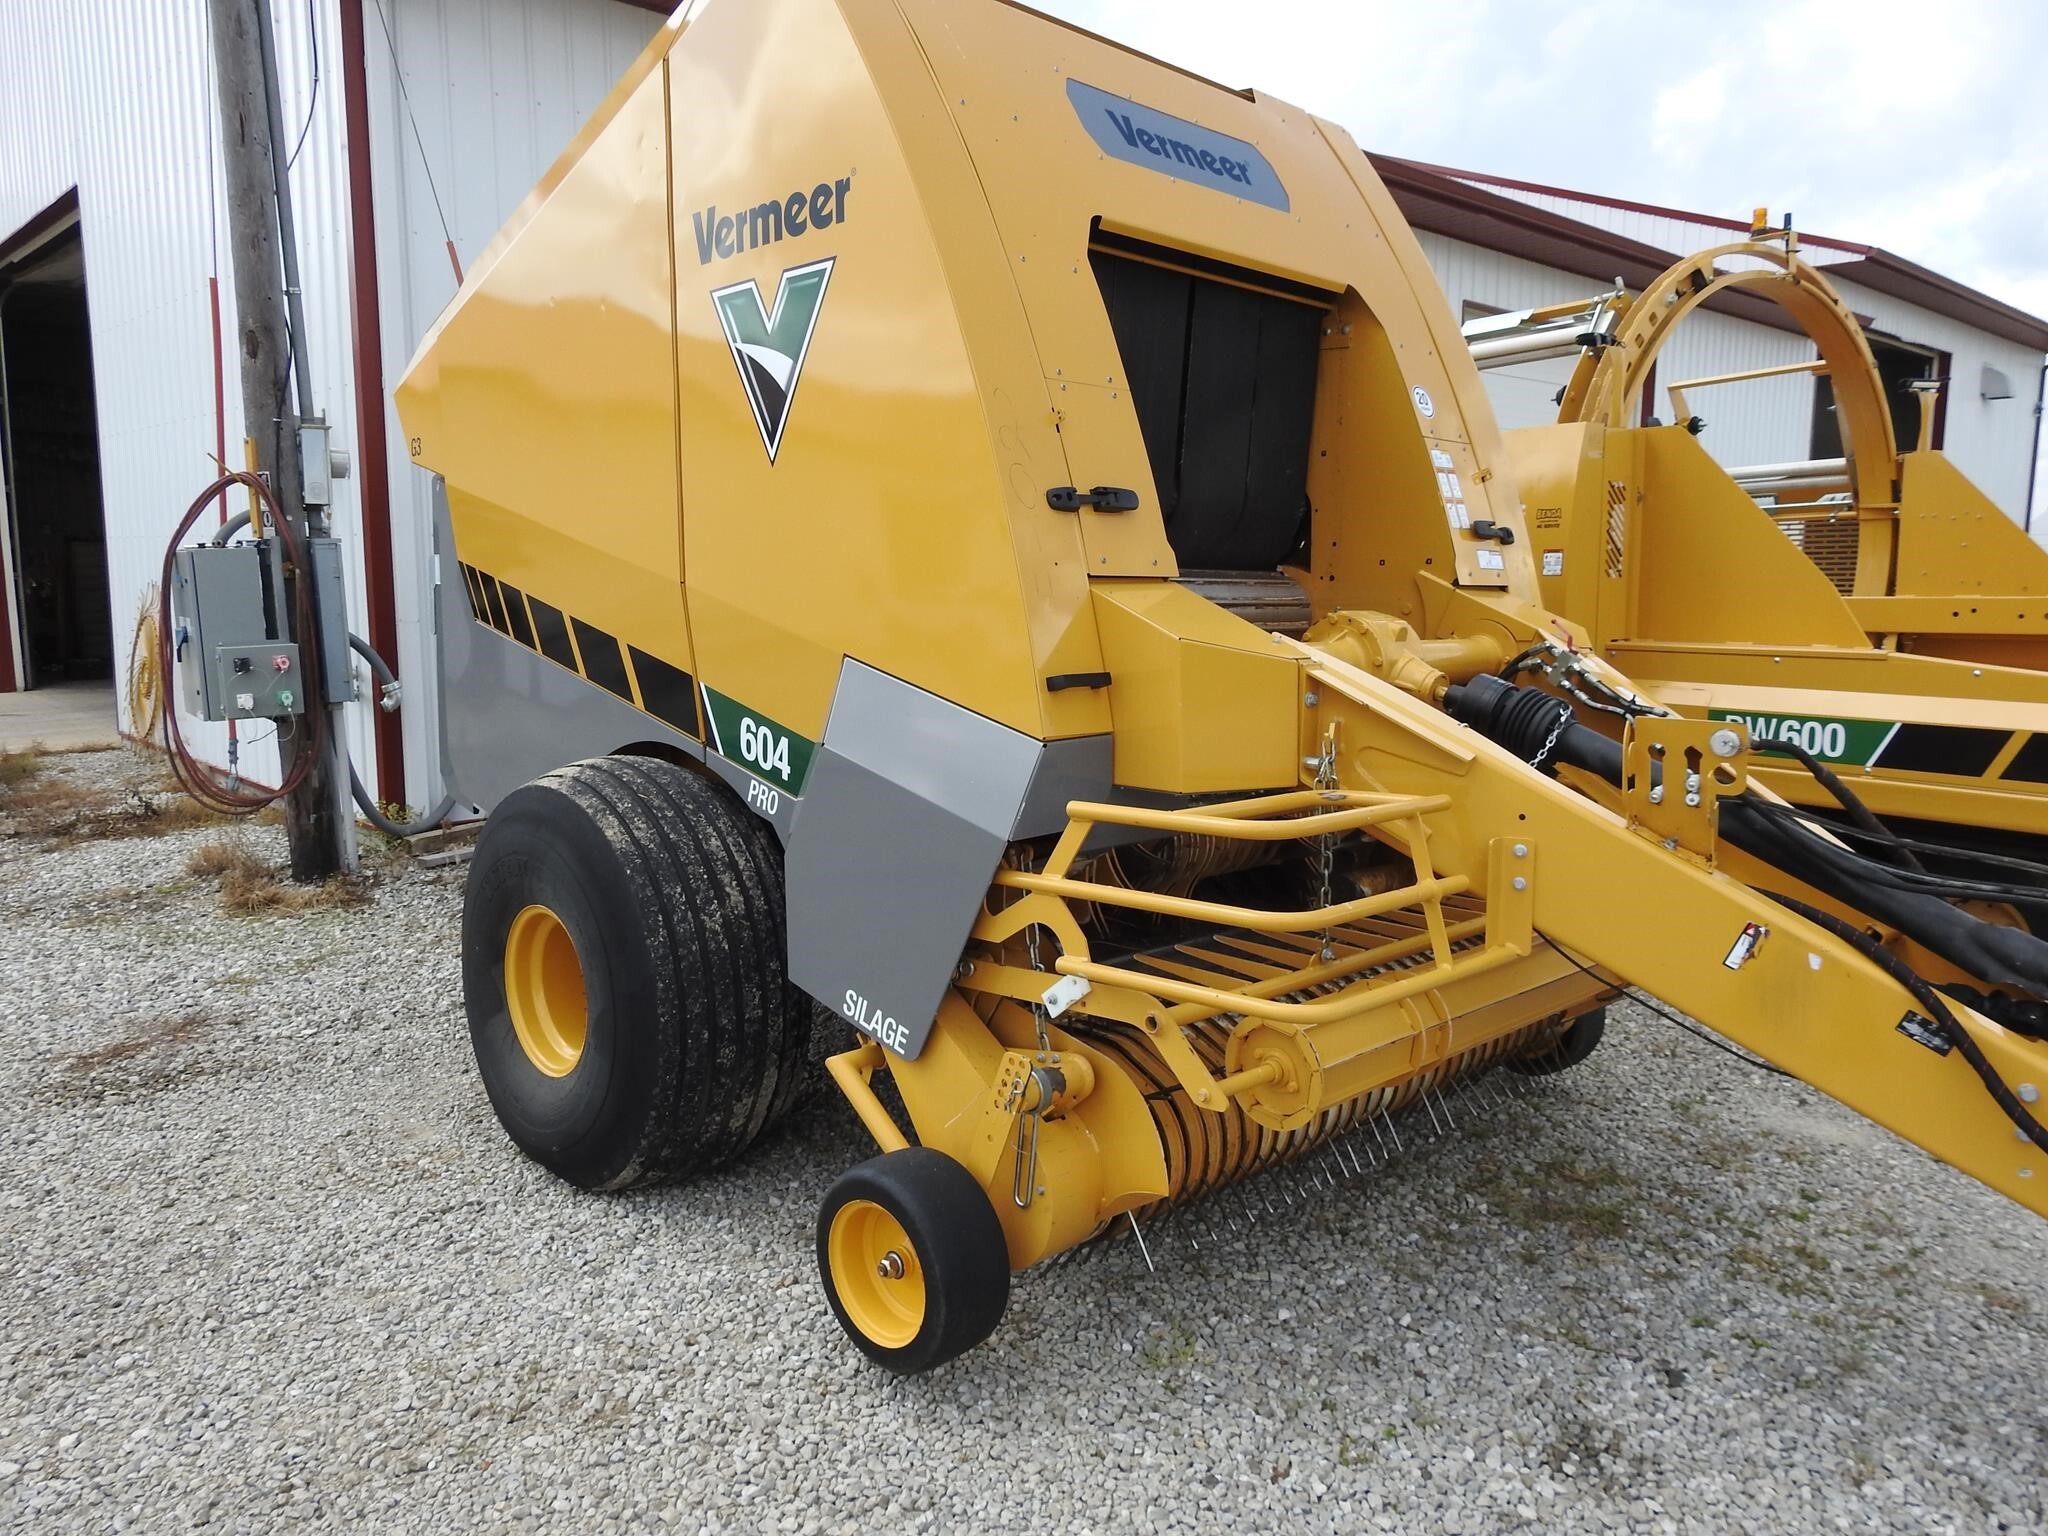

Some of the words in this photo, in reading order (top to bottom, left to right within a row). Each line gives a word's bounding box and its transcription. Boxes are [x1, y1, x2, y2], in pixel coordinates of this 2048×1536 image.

[1104, 108, 1252, 186] Vermeer
[692, 176, 851, 265] Vermeer
[410, 437, 421, 457] G3
[740, 716, 791, 781] 604
[1725, 714, 1846, 758] W600
[747, 779, 779, 815] PRO
[843, 989, 909, 1055] SILAGE
